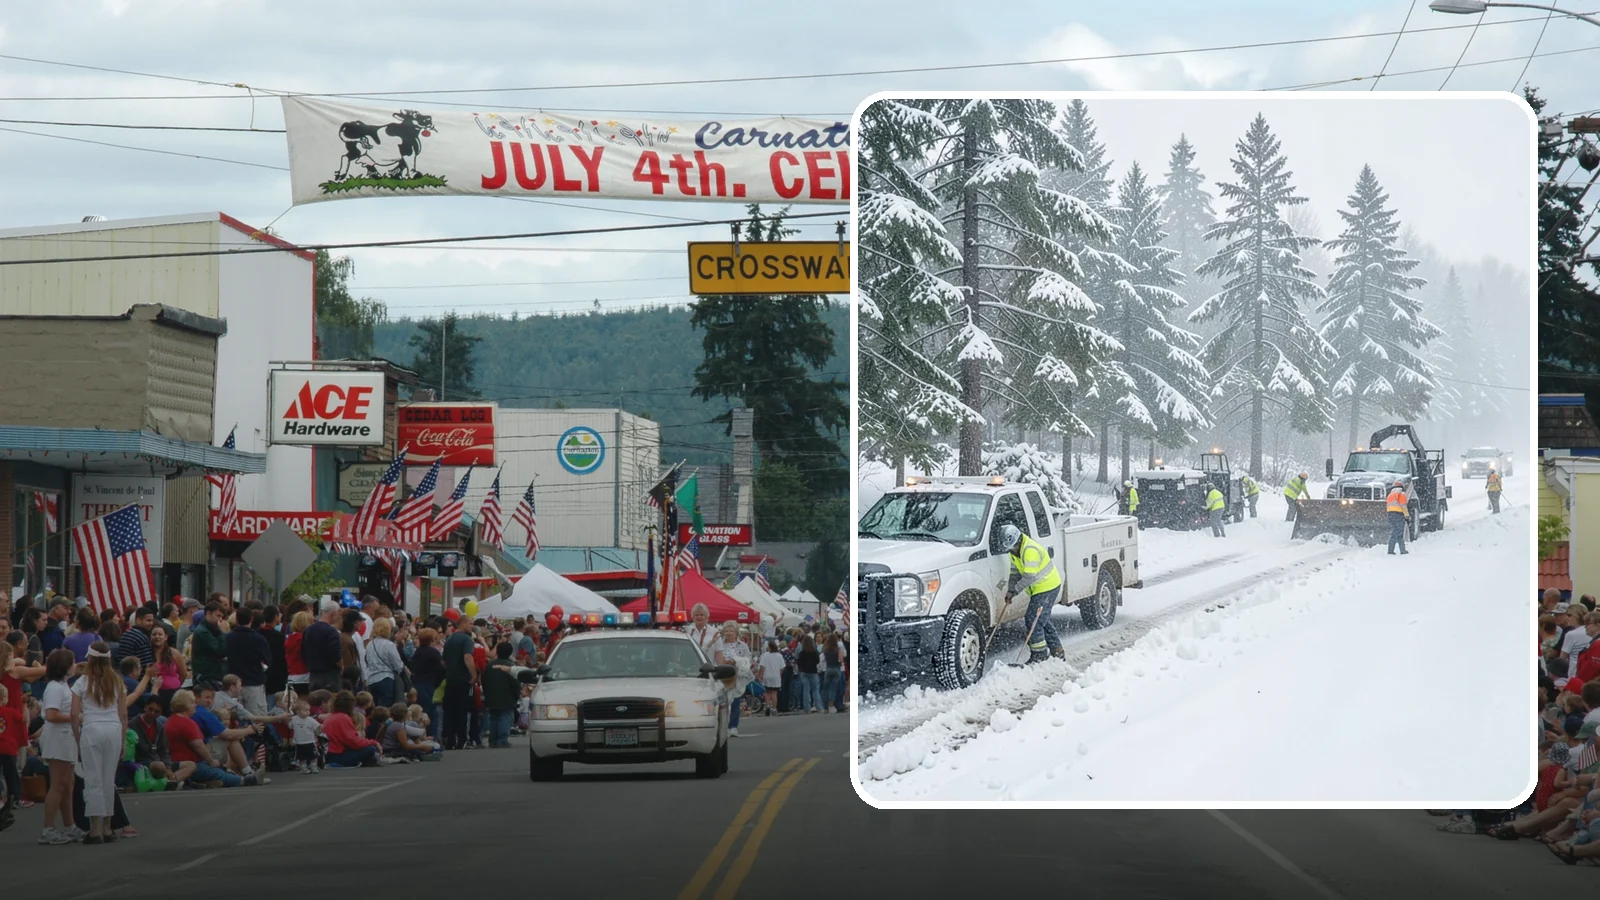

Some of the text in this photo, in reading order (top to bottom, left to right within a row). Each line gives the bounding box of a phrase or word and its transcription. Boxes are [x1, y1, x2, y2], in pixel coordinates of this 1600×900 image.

[695, 121, 850, 149] Carnat
[481, 141, 605, 192] JULY
[632, 150, 746, 198] 4th.
[697, 254, 850, 280] CROSSWA
[282, 380, 373, 420] ACE
[405, 408, 485, 422] CEDAR LOG
[283, 421, 371, 436] Hardware
[416, 428, 477, 447] Coca-Cola
[353, 467, 384, 480] Simpl
[83, 484, 155, 495] St. Vincent de Paul
[80, 503, 154, 522] THT
[688, 526, 741, 535] CRNATION
[699, 535, 730, 543] GLASS
